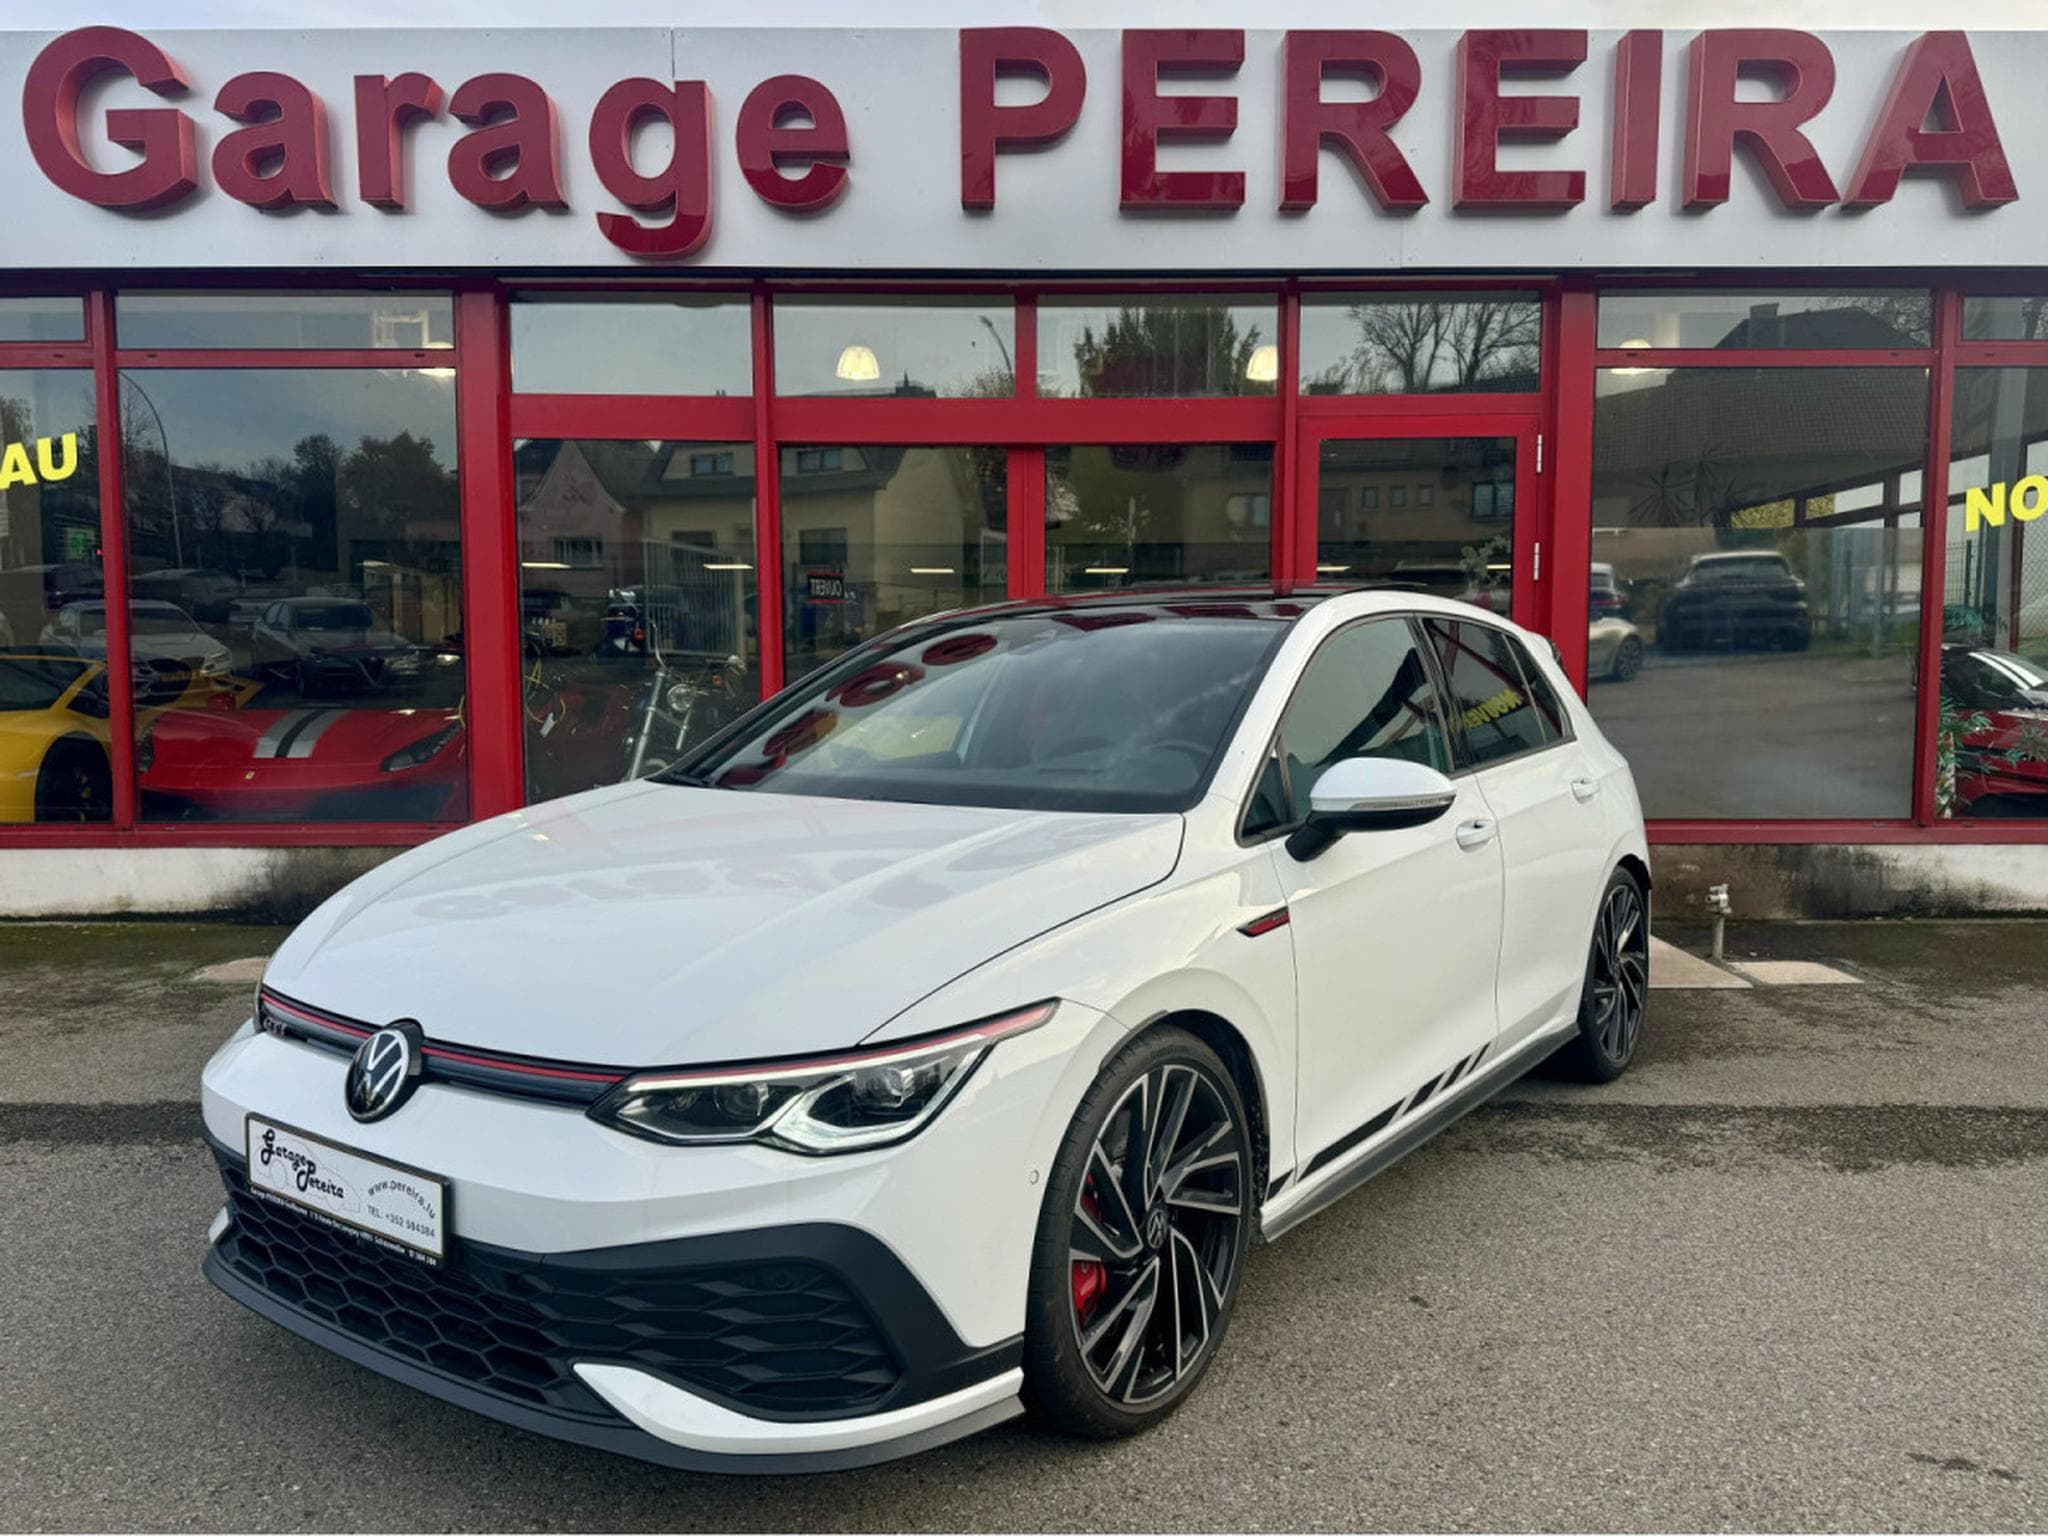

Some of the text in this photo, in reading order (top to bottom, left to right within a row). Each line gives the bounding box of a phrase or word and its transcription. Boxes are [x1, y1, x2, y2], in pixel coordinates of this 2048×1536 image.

[22, 26, 2020, 260] Garage PEREIRA
[261, 1128, 307, 1172] Garage
[296, 1160, 345, 1199] Pereira
[368, 1180, 437, 1220] www.pereira.lu
